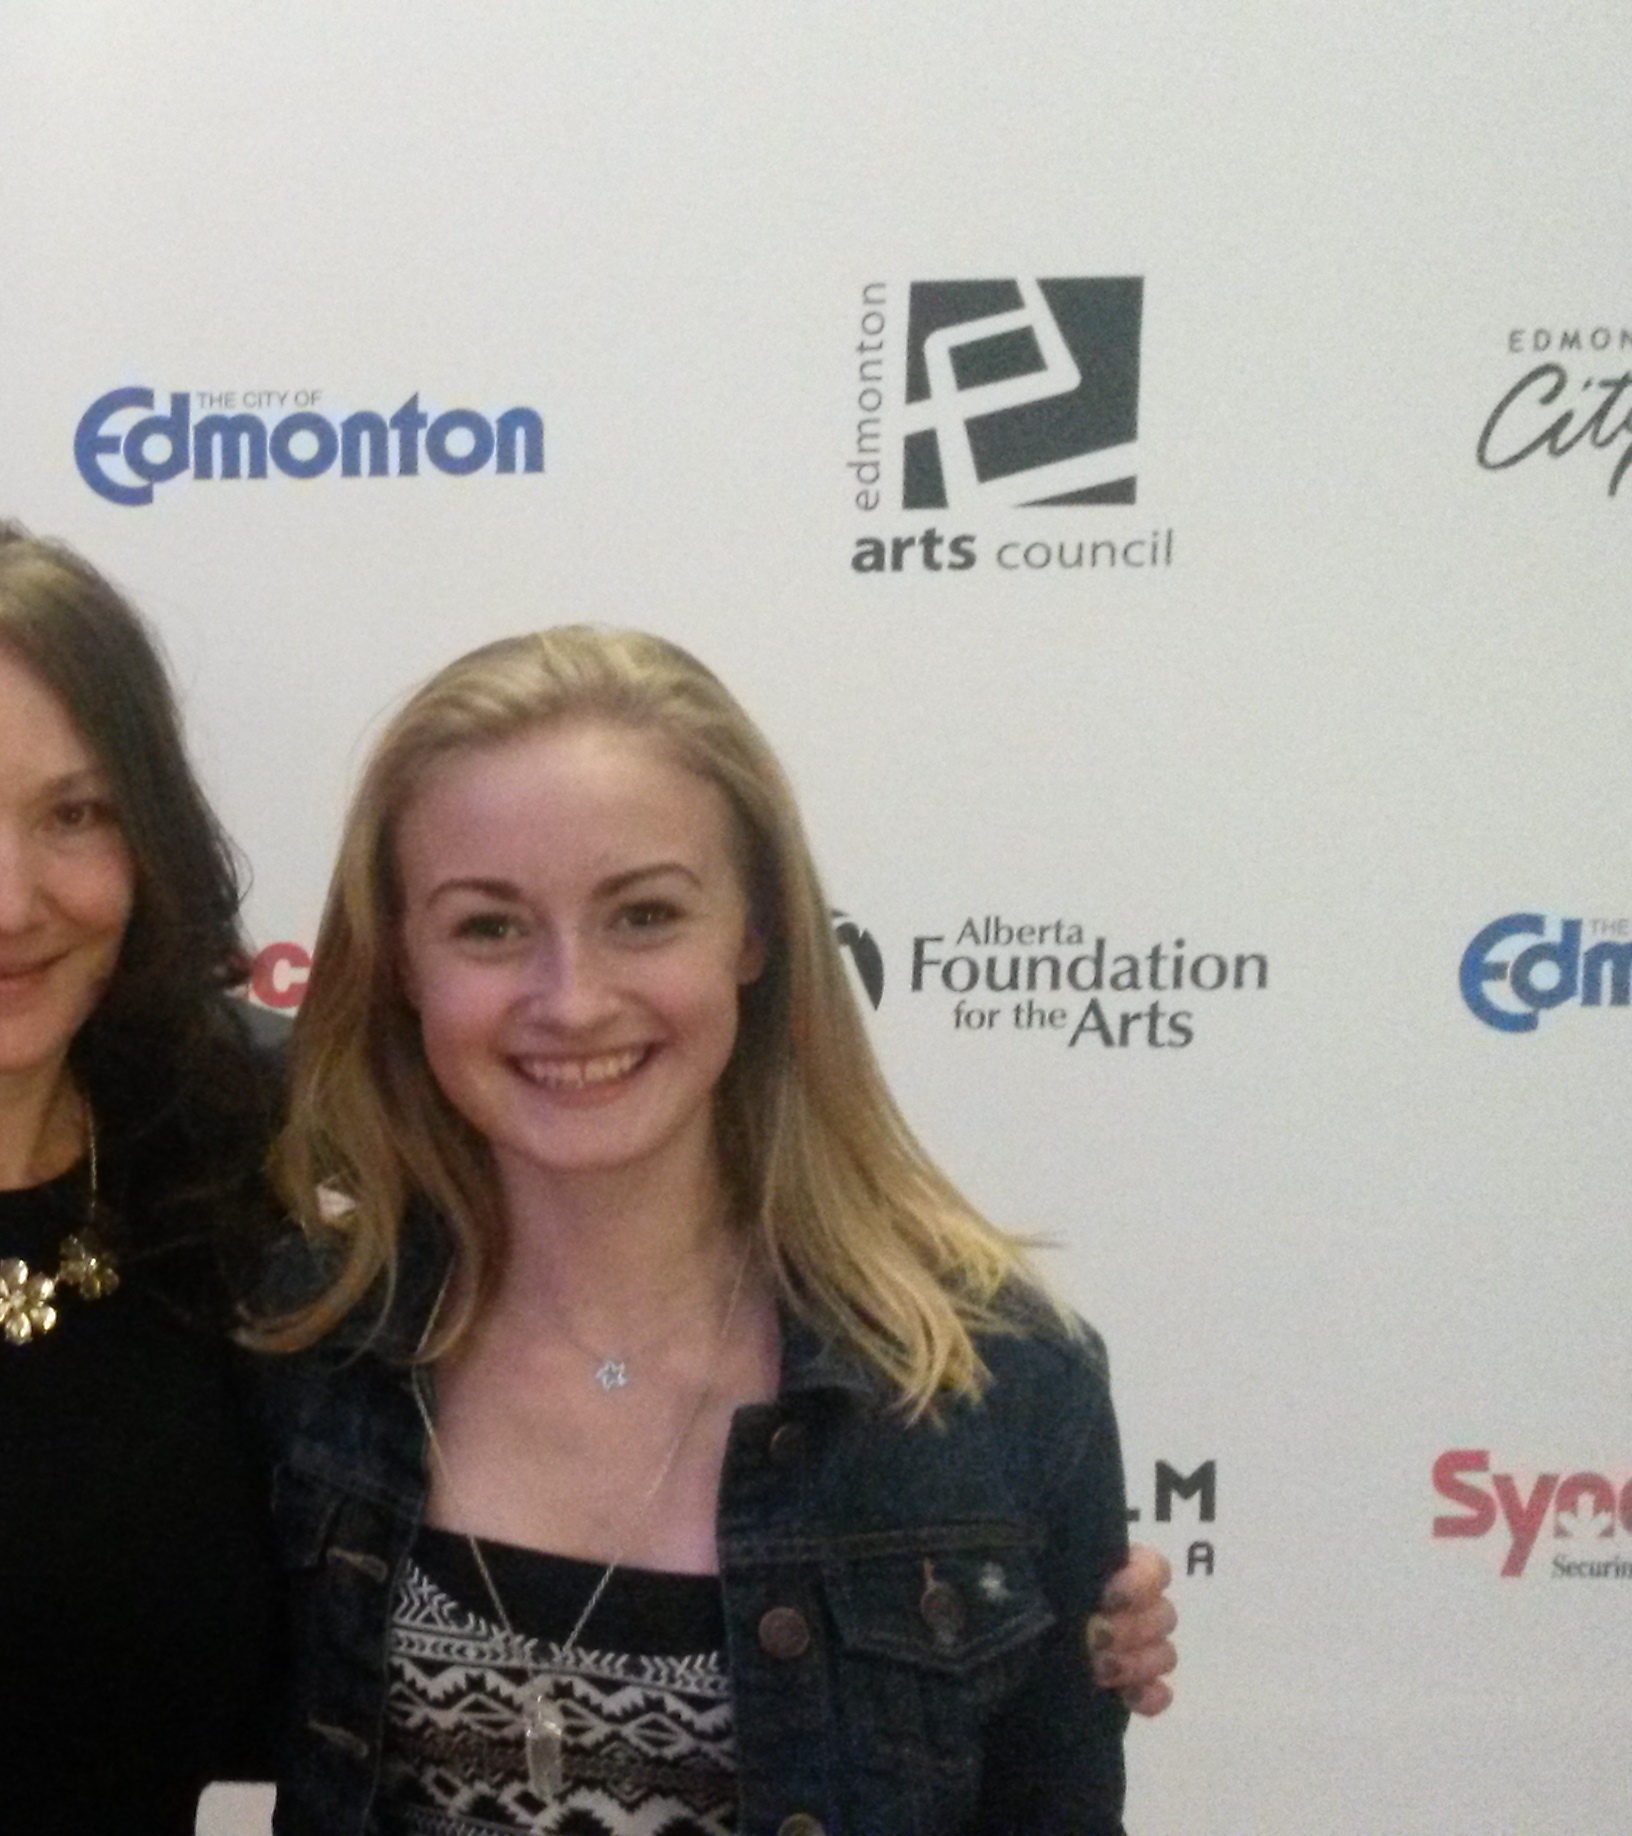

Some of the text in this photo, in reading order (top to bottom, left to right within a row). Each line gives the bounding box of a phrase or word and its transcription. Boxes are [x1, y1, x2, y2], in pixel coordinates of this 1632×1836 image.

[198, 391, 323, 409] THE CITY OF
[847, 282, 886, 511] edmonton
[74, 386, 545, 507] Edmonton
[851, 528, 1174, 573] arts council
[956, 916, 1085, 946] Alberta
[911, 937, 1269, 992] Foundation
[954, 998, 1195, 1049] for the Arts
[1432, 1449, 1632, 1577] Syn
